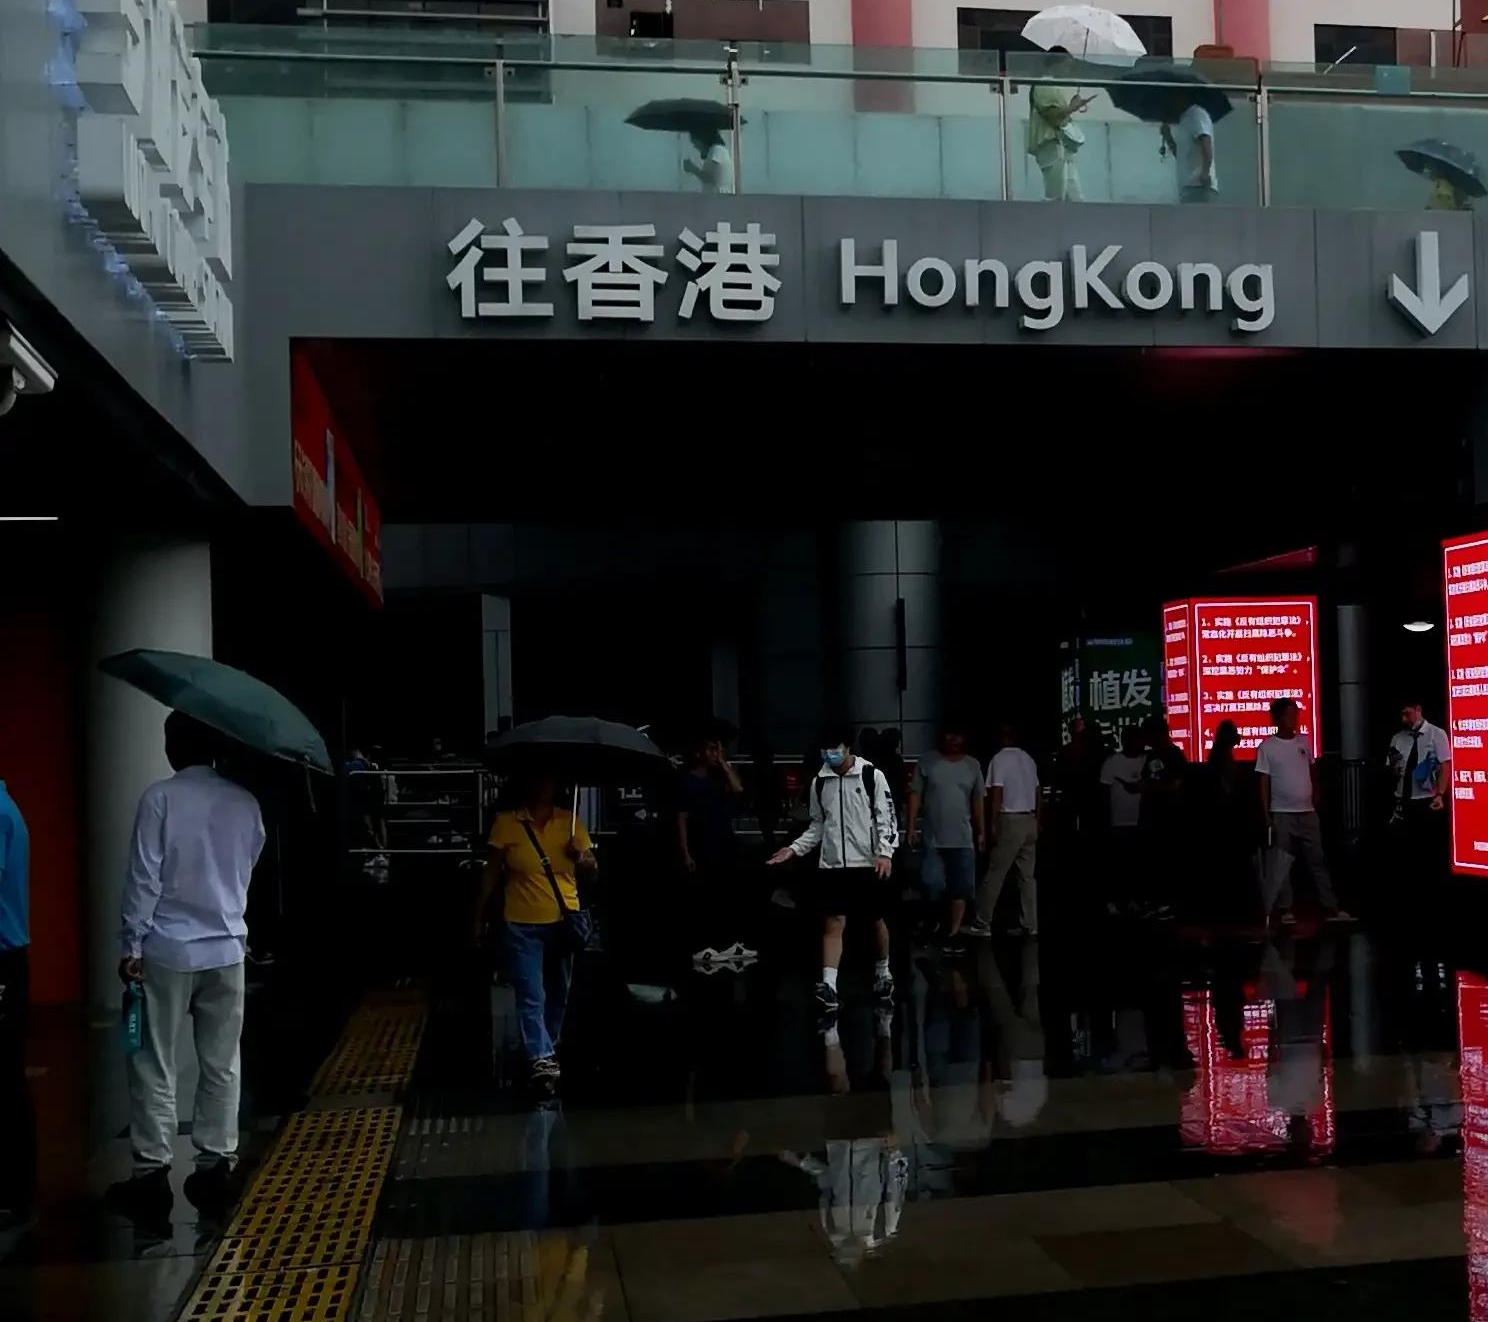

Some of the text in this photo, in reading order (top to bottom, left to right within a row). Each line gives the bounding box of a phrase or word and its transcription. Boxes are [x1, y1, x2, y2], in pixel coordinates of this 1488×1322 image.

[445, 217, 783, 323] 往香港
[840, 237, 1275, 331] HongKong
[1089, 669, 1152, 711] 植发
